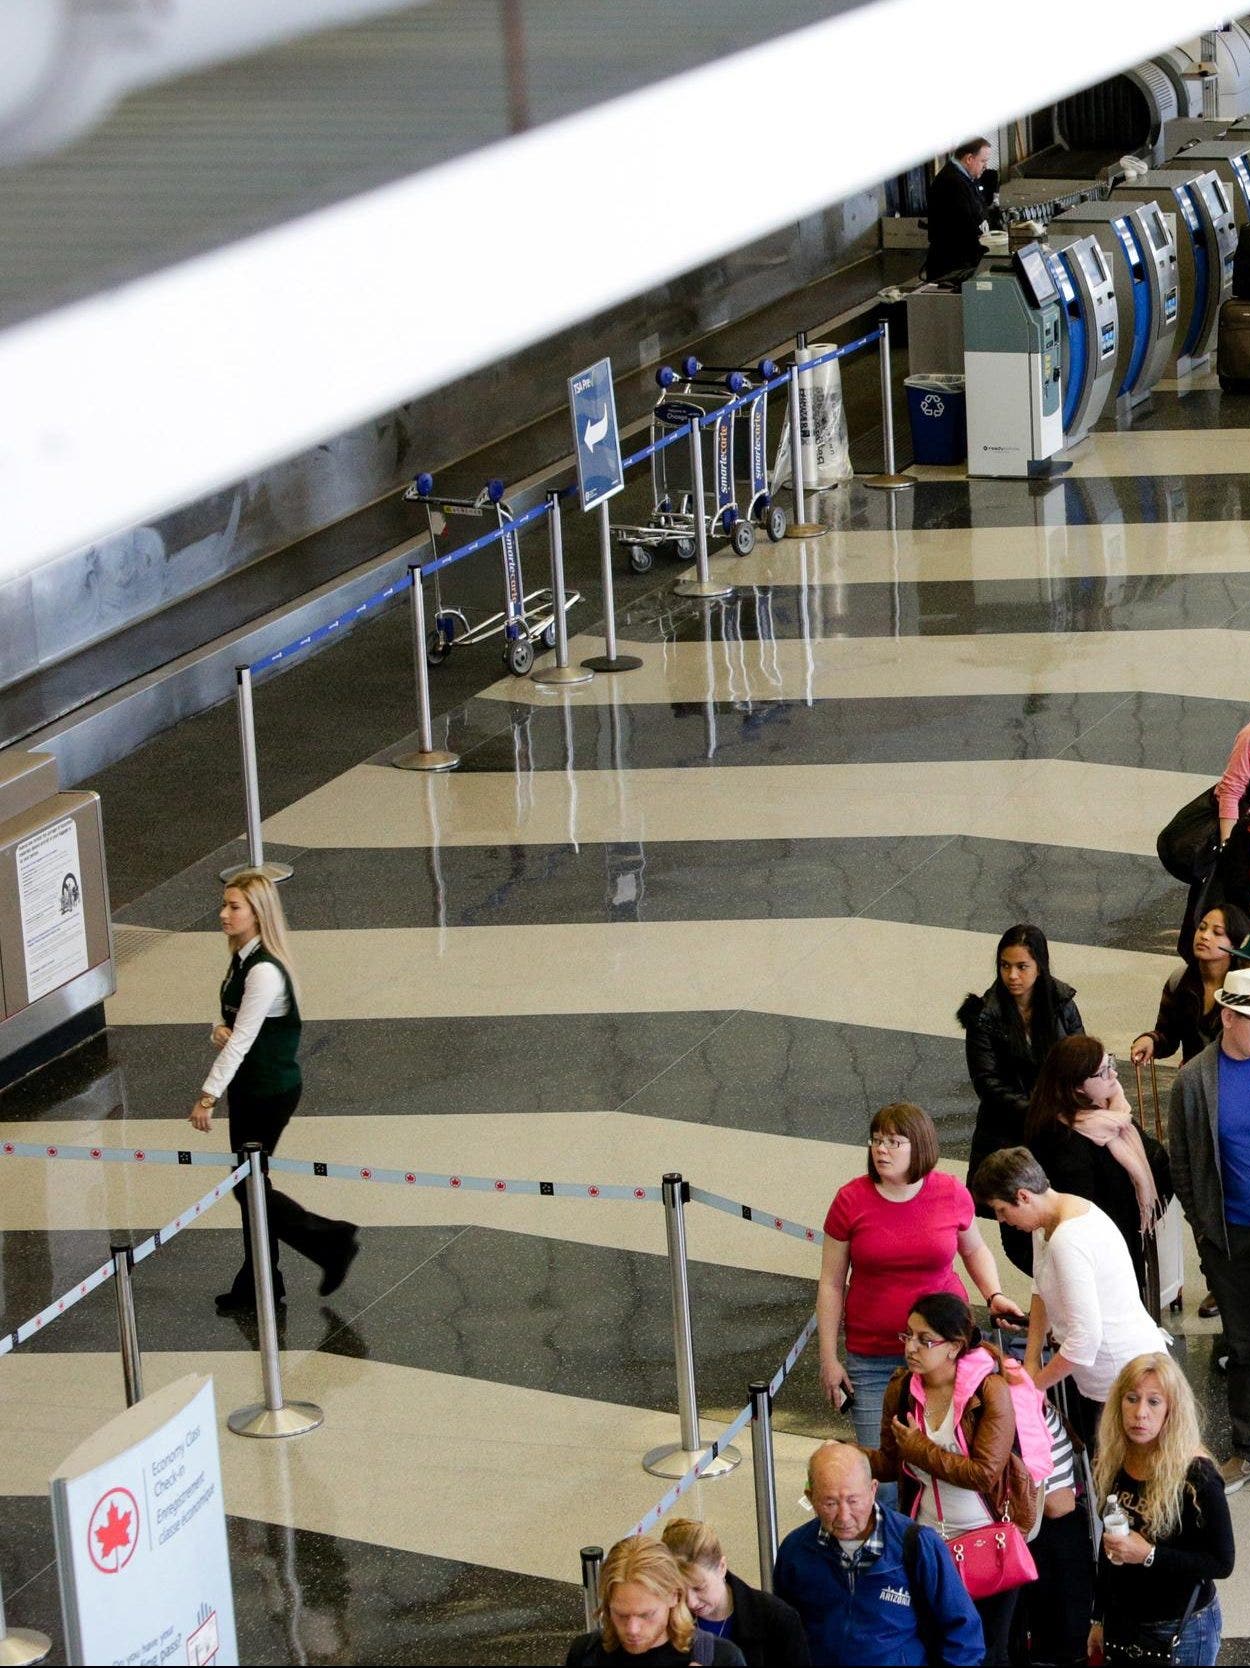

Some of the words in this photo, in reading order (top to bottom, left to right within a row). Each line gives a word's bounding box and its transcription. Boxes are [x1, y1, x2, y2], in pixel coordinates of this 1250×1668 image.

[573, 381, 583, 395] TSA
[719, 424, 728, 494] smartecarte
[753, 411, 762, 480] smartecarte
[152, 1444, 185, 1477] Economy
[186, 1425, 200, 1448] Class
[154, 1464, 185, 1498] Check-in
[879, 1591, 911, 1607] ARIZONA
